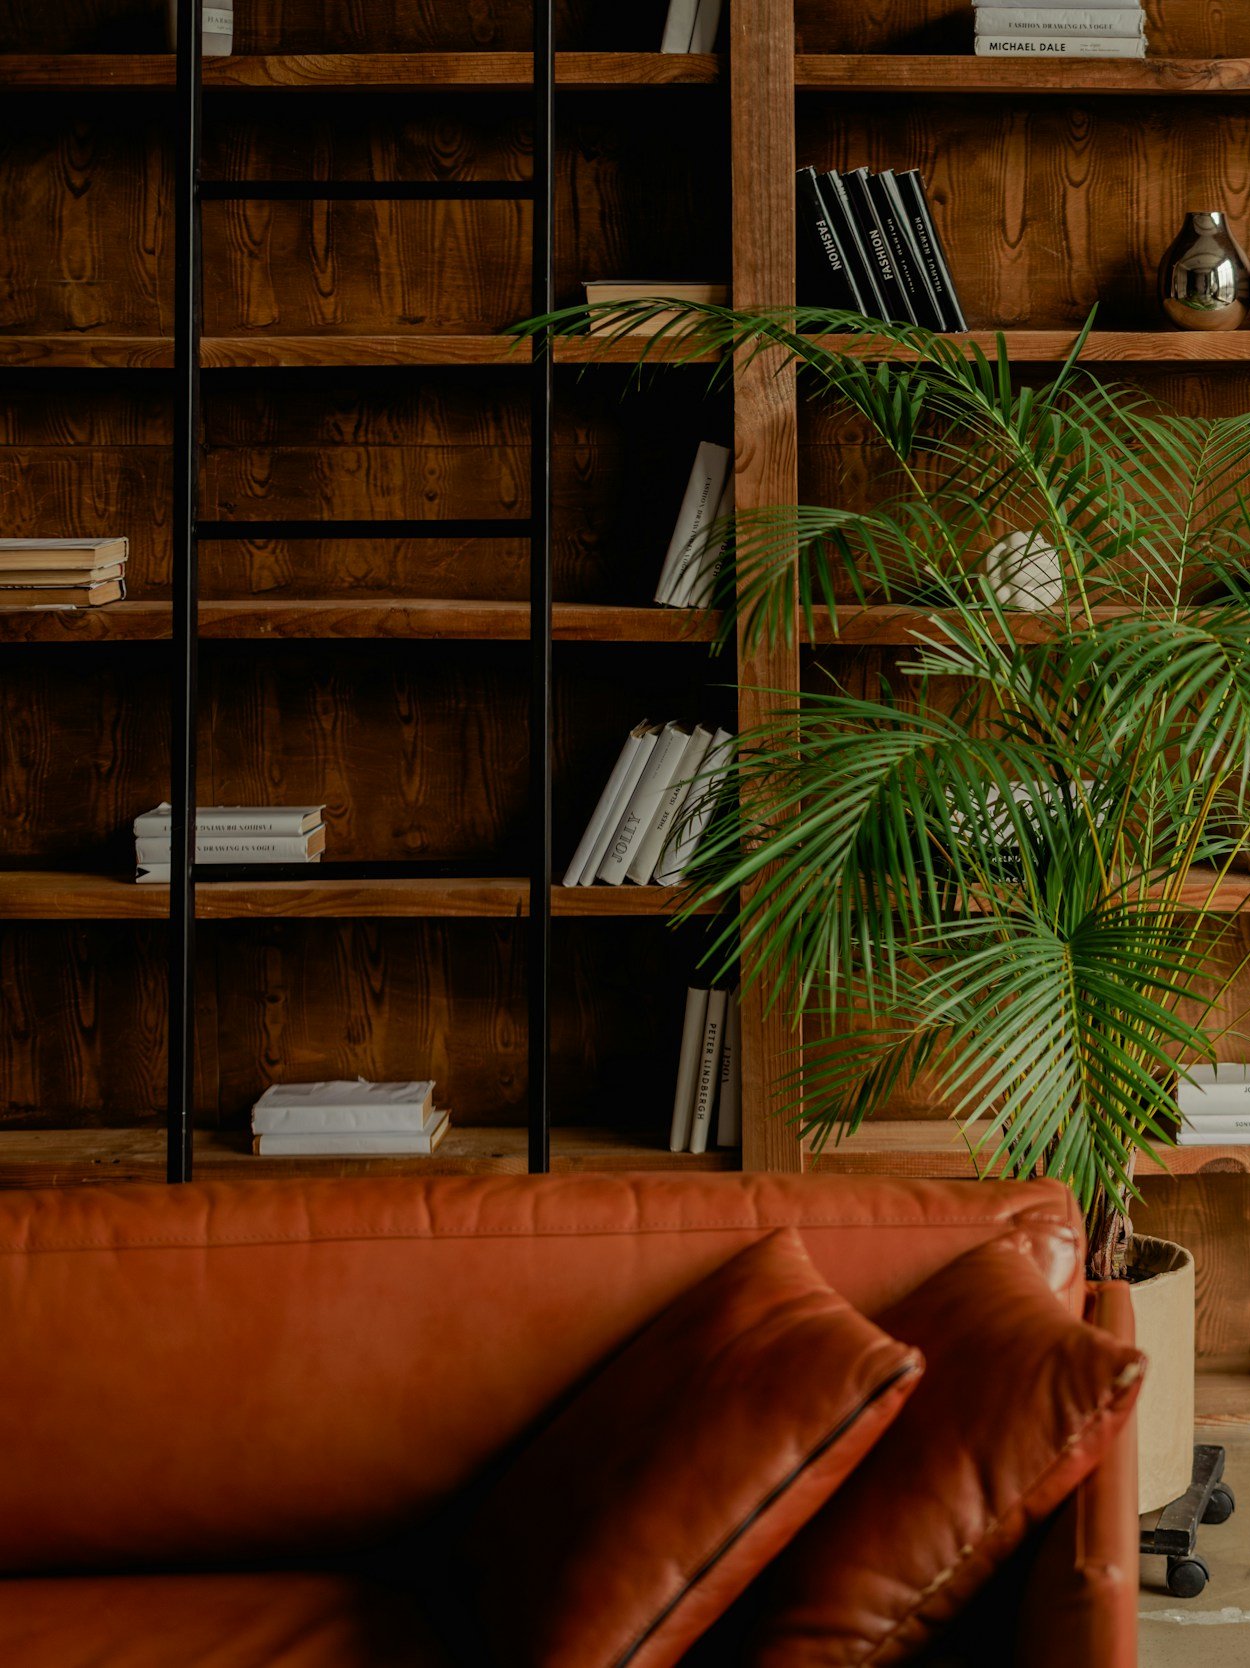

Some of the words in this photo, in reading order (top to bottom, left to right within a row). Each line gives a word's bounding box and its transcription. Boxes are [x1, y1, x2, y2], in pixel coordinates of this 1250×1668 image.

[1042, 22, 1077, 30] DRAWING
[989, 42, 1036, 52] MICHAEL
[1039, 43, 1067, 52] DALE
[816, 219, 842, 271] FASHION
[914, 216, 931, 255] NEWTON
[869, 229, 894, 281] FASHION
[926, 258, 943, 293] HELMUT
[200, 824, 237, 832] DRAWING
[238, 823, 273, 831] FASHION
[611, 812, 642, 863] JOLLY
[657, 811, 670, 831] THESE
[706, 1023, 717, 1055] PETER
[696, 1059, 713, 1120] LINDBERGH
